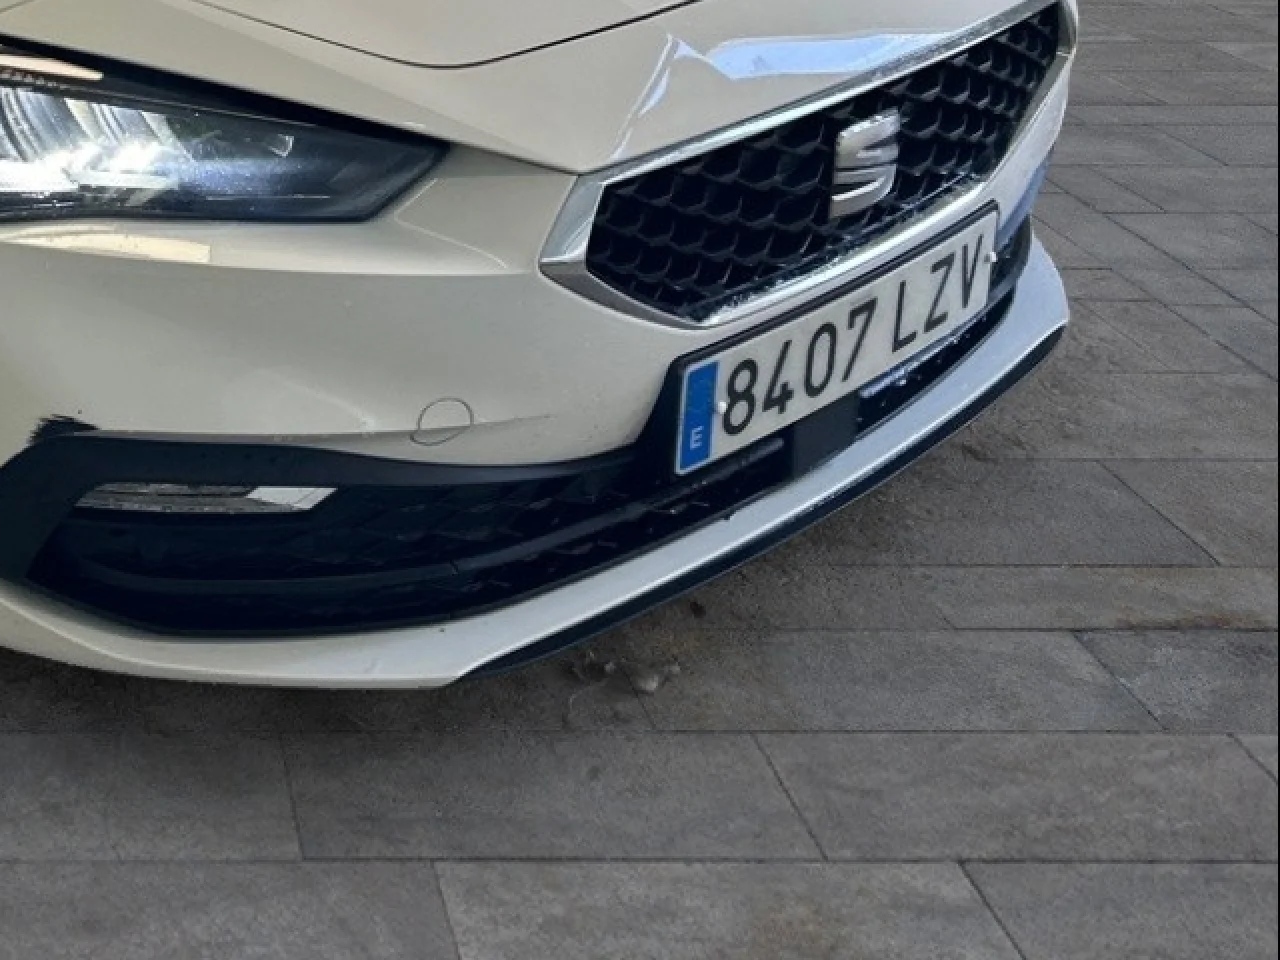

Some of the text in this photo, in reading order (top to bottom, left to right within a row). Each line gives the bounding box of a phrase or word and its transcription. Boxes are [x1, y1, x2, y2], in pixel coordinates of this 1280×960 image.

[722, 233, 984, 436] 8407 LZV
[689, 425, 706, 451] E
